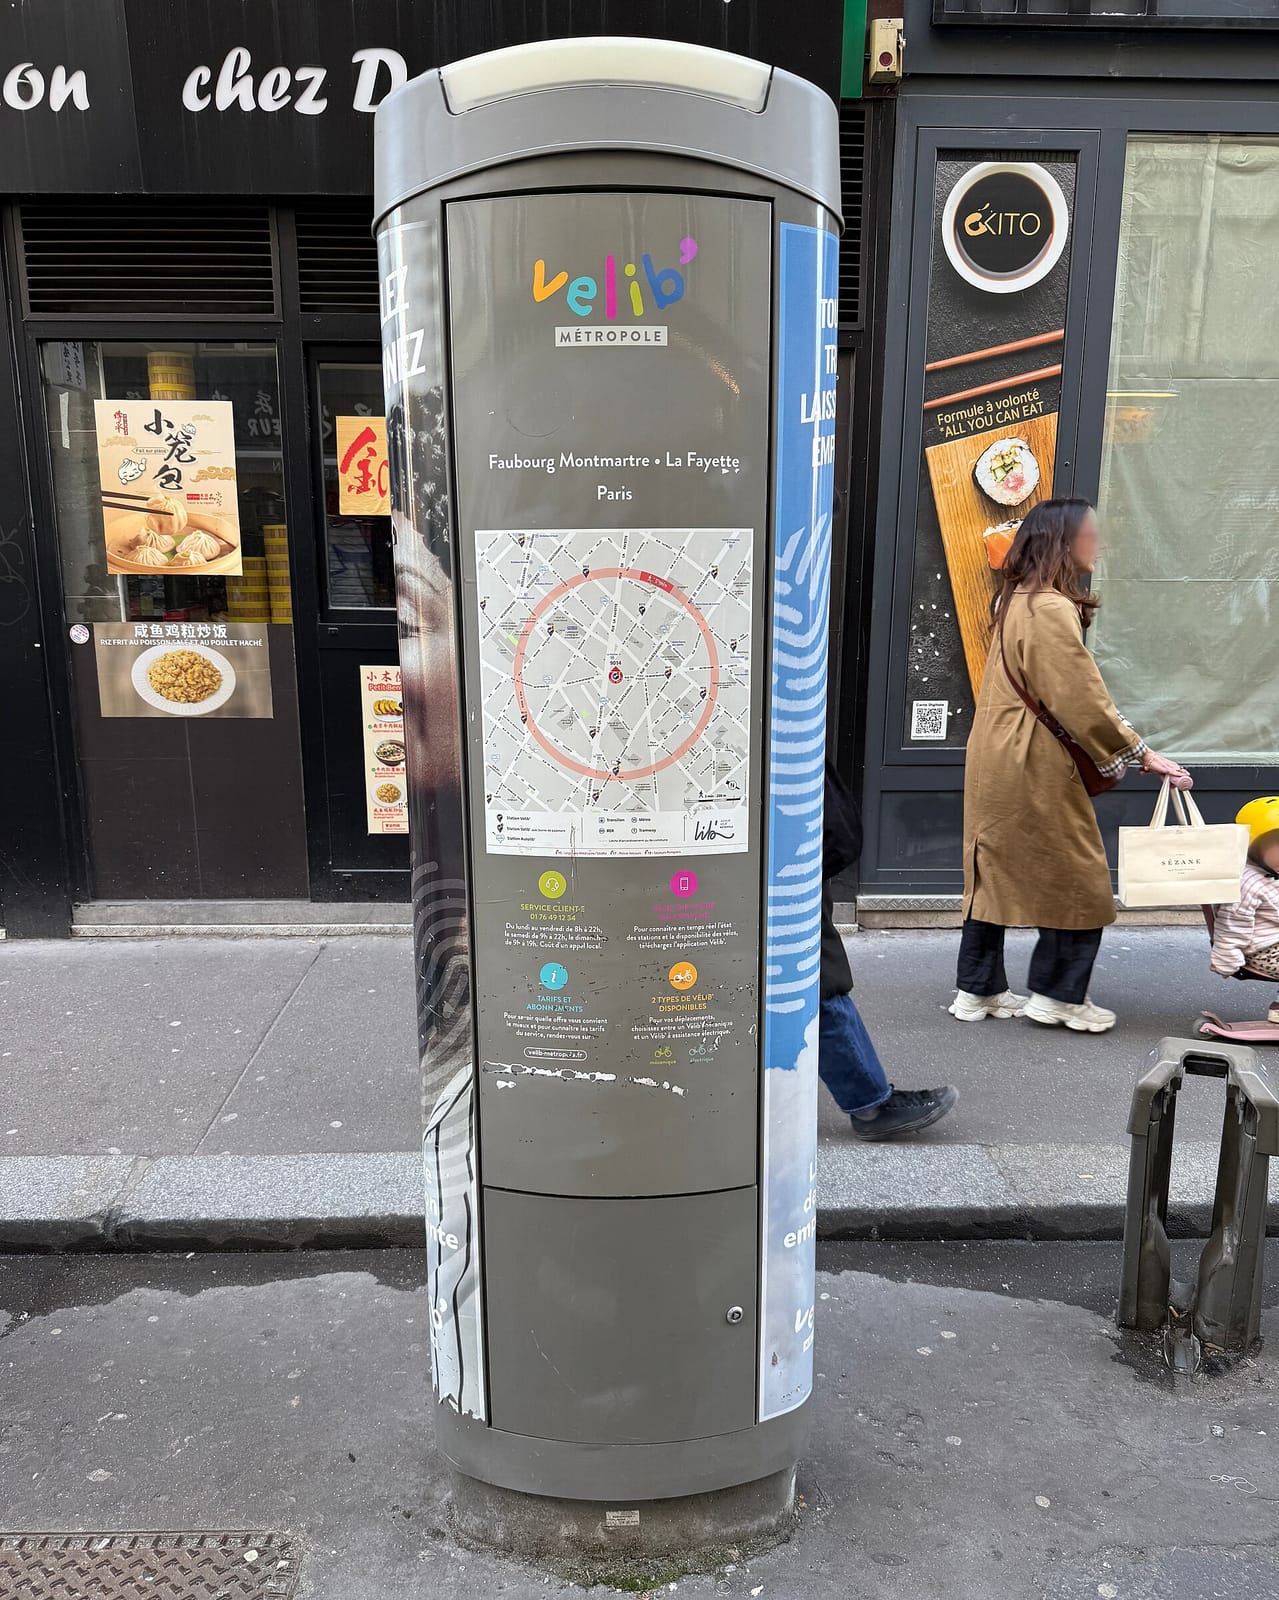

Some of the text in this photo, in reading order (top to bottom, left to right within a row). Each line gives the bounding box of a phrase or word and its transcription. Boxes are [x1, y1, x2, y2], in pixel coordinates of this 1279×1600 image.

[182, 46, 328, 115] chez
[559, 328, 663, 343] MÉTROPOLE
[937, 388, 1040, 425] Formule à volonté
[967, 414, 994, 431] YOU
[996, 407, 1020, 424] CAN
[1022, 401, 1044, 417] EAT
[488, 452, 740, 473] Faubourg Montmartre La Fayette
[597, 485, 633, 501] Paris
[134, 623, 228, 639] 咸鱼鸡粒炒饭
[239, 638, 263, 647] HACHÉ
[1160, 858, 1201, 866] SÉZANE
[520, 904, 551, 912] SERVICE
[516, 923, 531, 931] lundi
[539, 924, 565, 932] vendredi
[588, 926, 603, 934] 22h,
[706, 922, 717, 930] réel
[511, 931, 530, 939] samedi
[553, 933, 568, 941] 22h,
[575, 933, 607, 943] dimanch
[676, 931, 711, 941] disponibilité
[505, 938, 512, 946] de
[555, 941, 568, 949] d'un
[569, 942, 585, 951] appel
[586, 942, 603, 950] local.
[639, 941, 672, 950] téléchargez
[673, 940, 708, 949] l'application
[537, 995, 561, 1003] TARIFS
[659, 1003, 707, 1012] DISPONIBLES
[535, 1015, 552, 1023] quelle
[649, 1016, 663, 1024] Pour
[546, 1032, 581, 1040] rendez-vous
